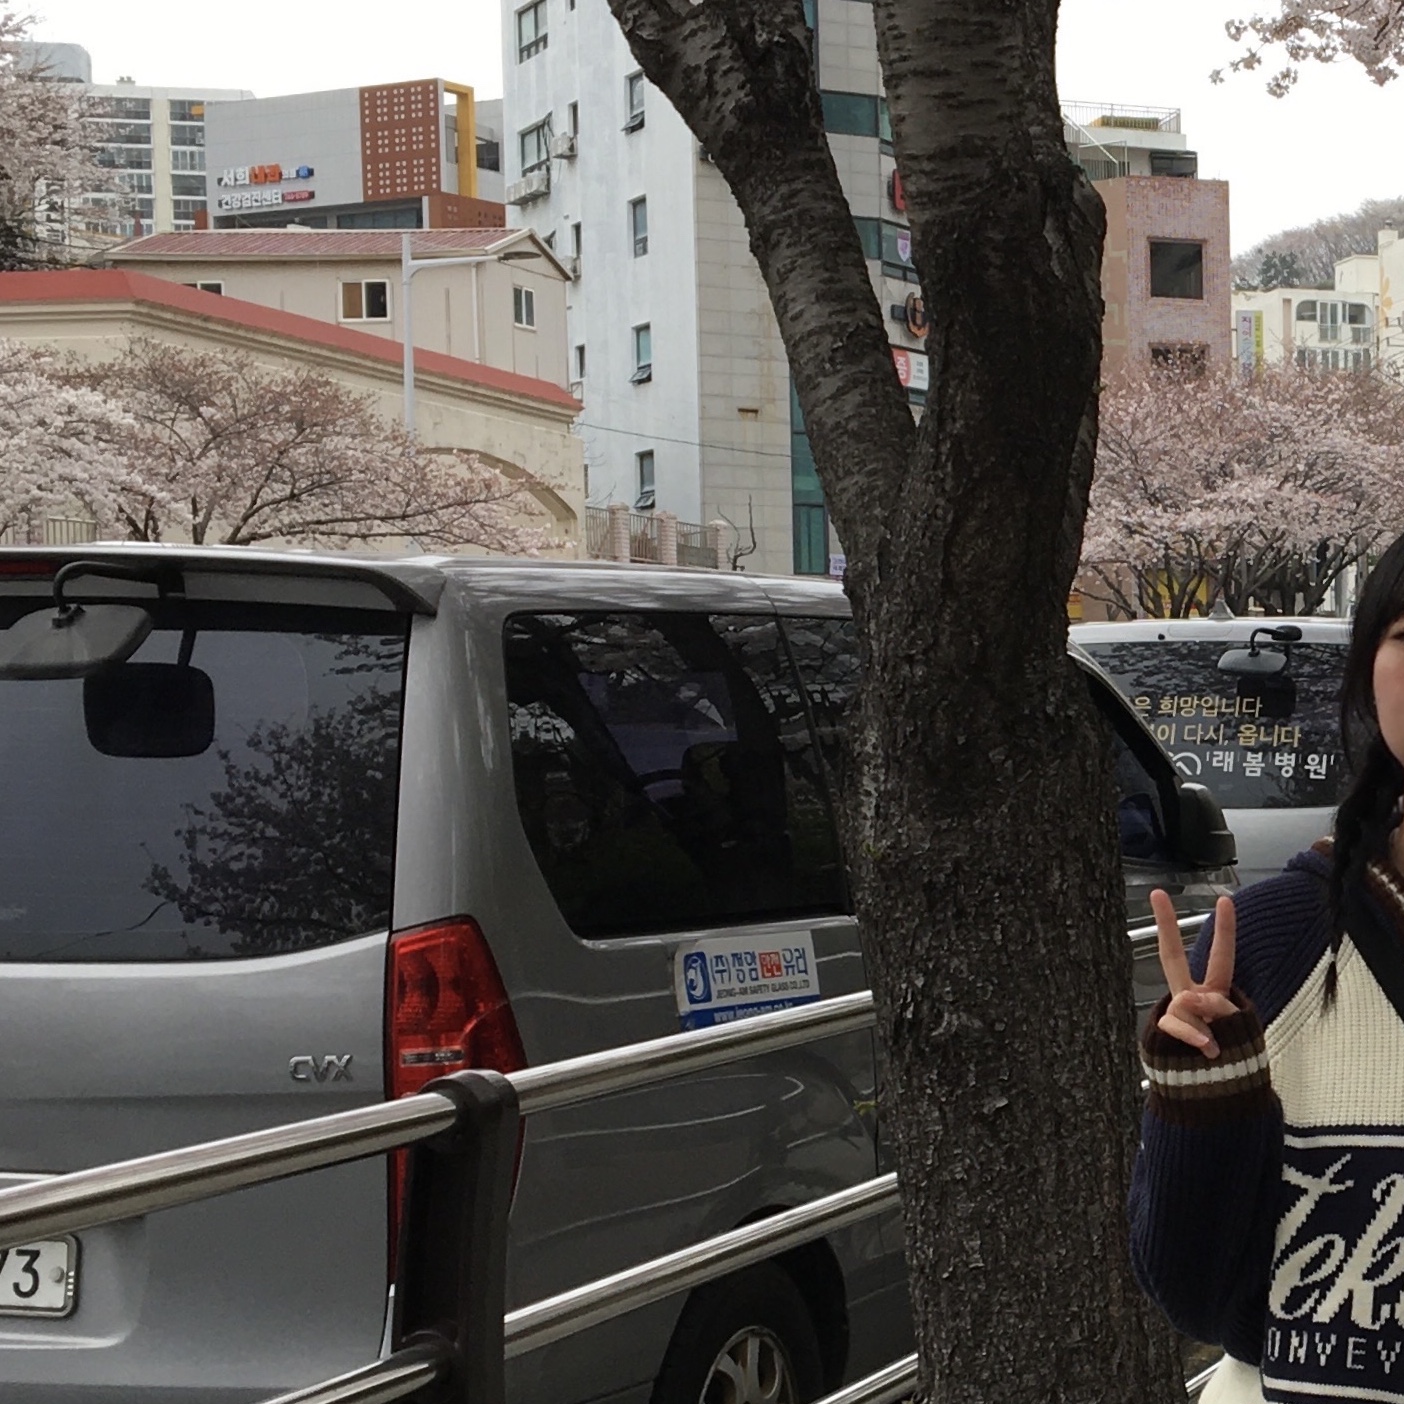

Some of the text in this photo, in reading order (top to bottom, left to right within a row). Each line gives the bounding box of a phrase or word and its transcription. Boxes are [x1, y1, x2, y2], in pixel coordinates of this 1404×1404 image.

[1158, 695, 1263, 718] 희망입니다
[1150, 723, 1176, 745] 이
[1237, 723, 1302, 748] 옵니다
[749, 984, 770, 994] SAFETY
[771, 981, 789, 993] GLASS
[289, 1054, 353, 1082] CVX
[0, 1249, 41, 1298] 3
